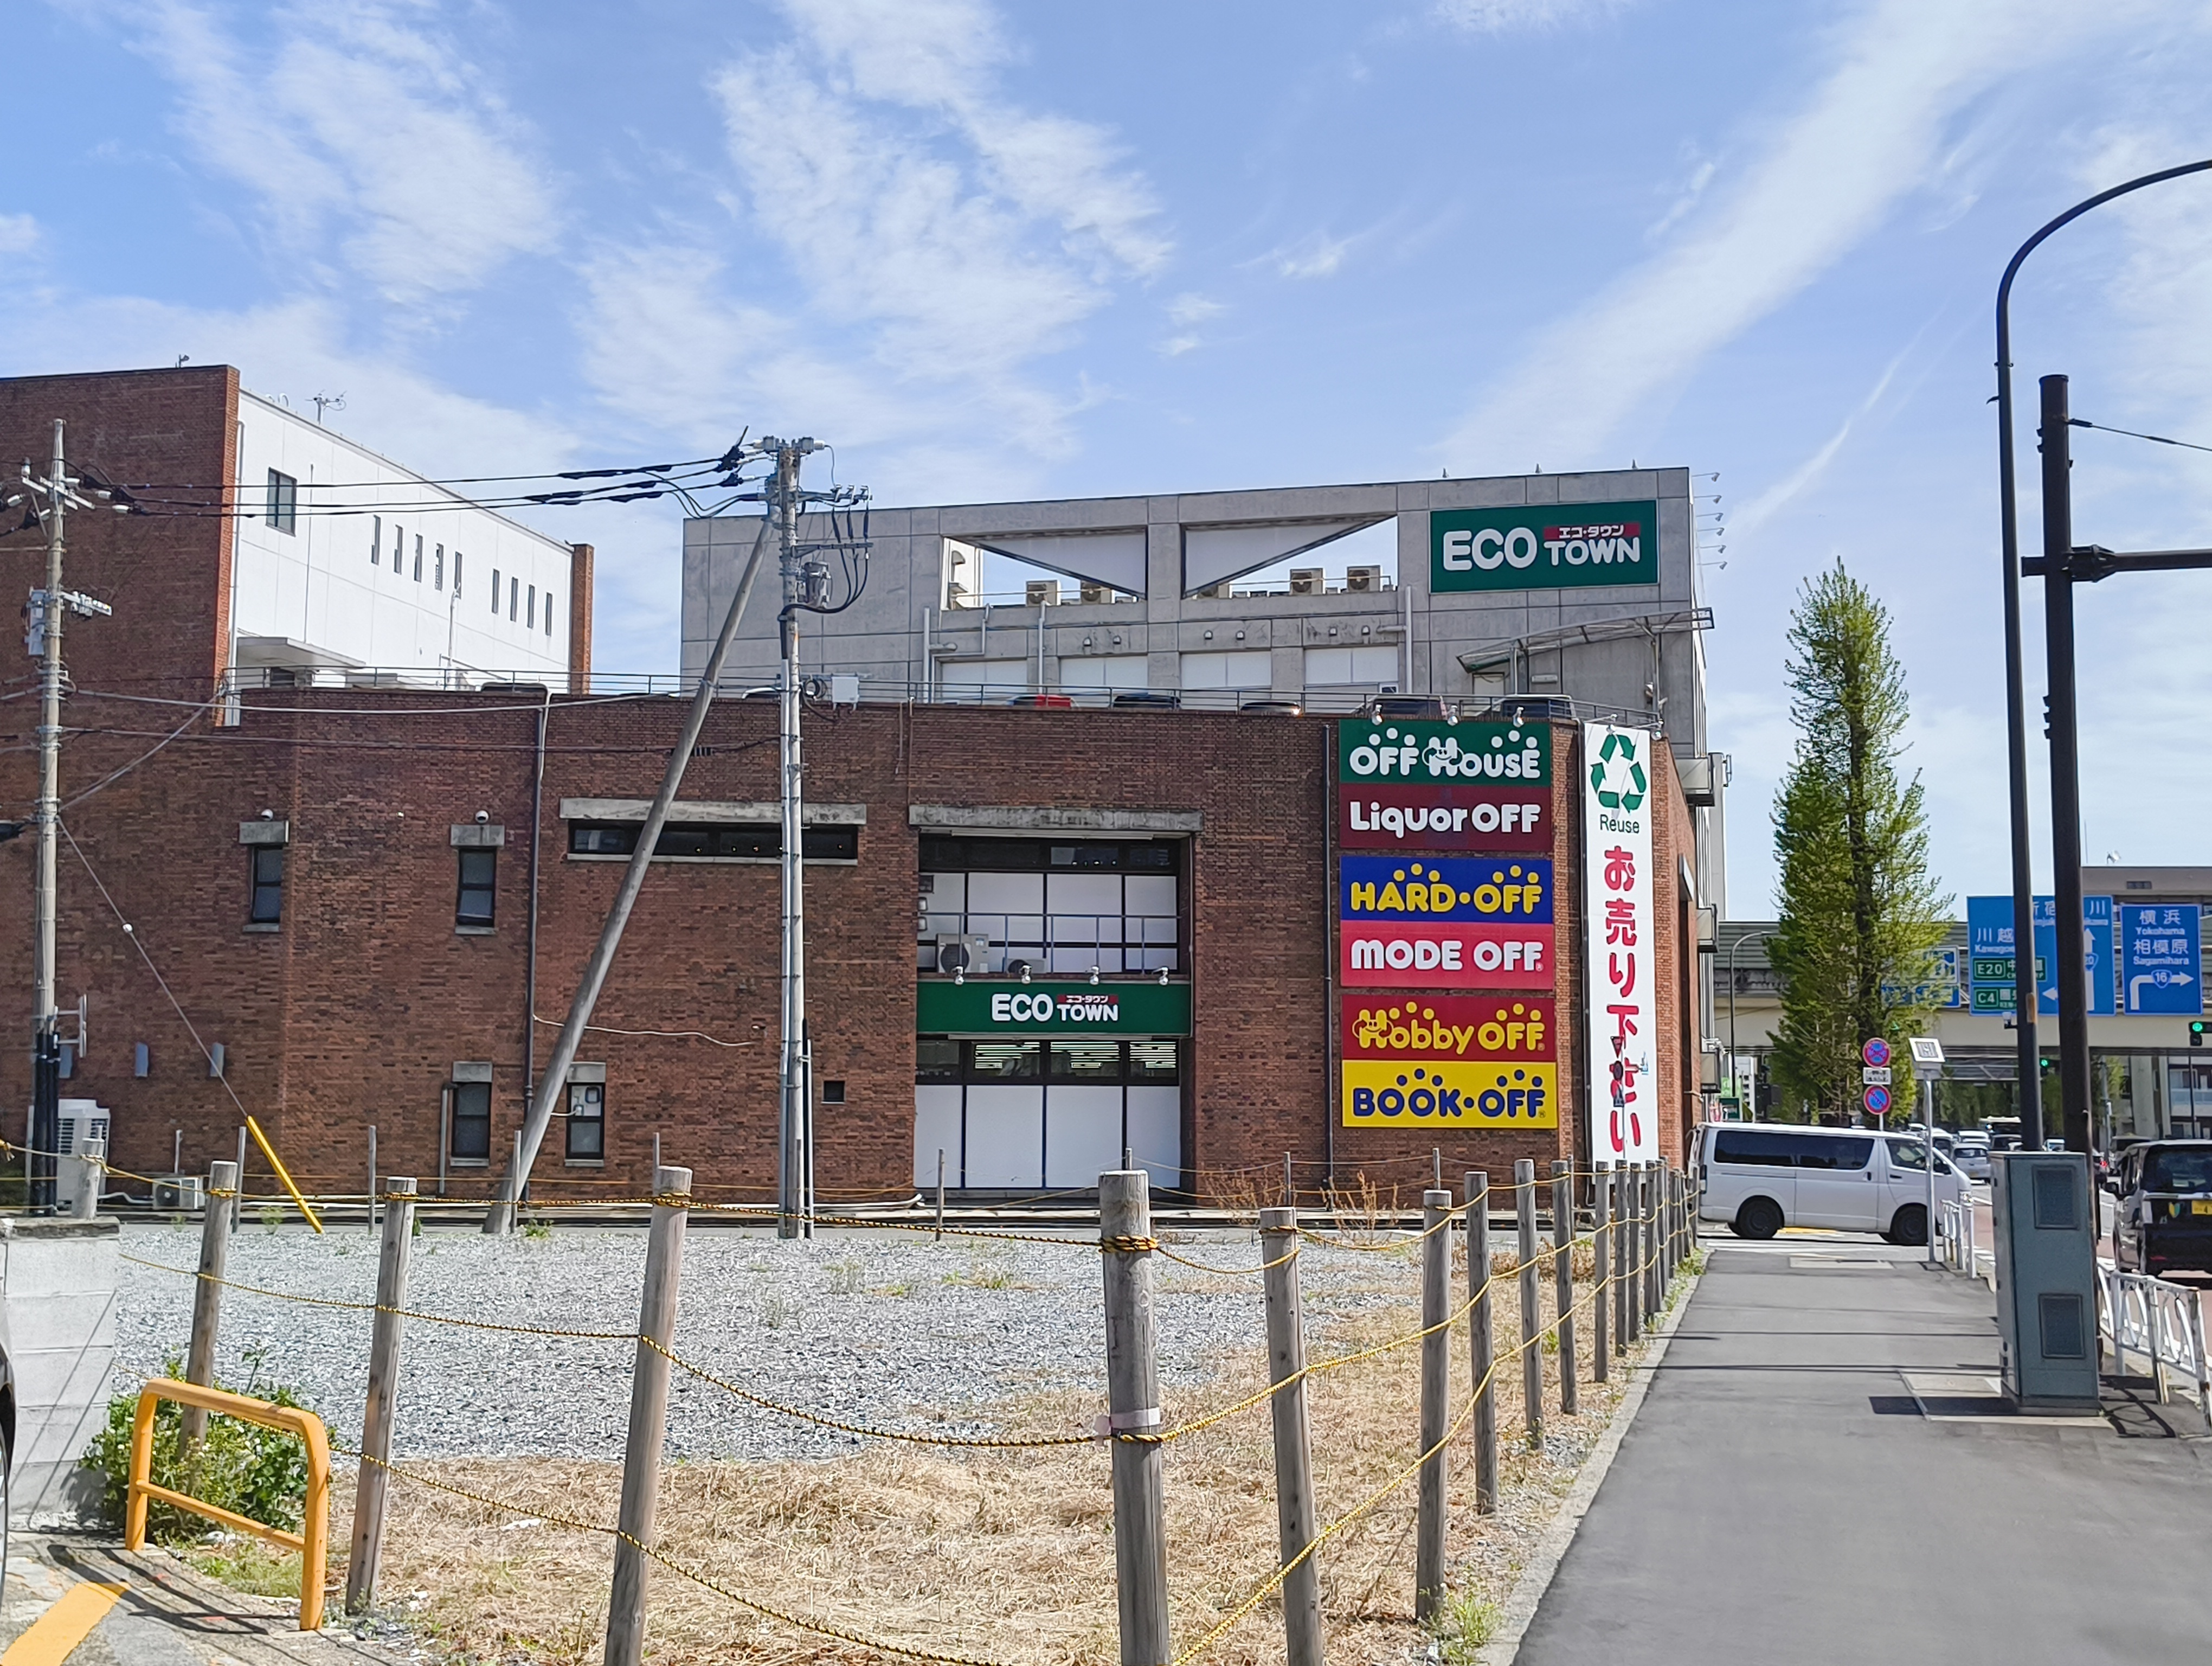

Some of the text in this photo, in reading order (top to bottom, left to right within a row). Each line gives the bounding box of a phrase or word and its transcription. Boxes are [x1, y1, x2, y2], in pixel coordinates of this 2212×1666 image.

[1559, 524, 1624, 538] エコ・タウン
[1443, 527, 1641, 571] ECO TOWN
[1349, 746, 1419, 776] OFF
[1349, 801, 1541, 838] Liquor OFF
[1600, 814, 1640, 834] Reuse
[2139, 909, 2181, 925] 横浜
[2134, 927, 2185, 935] Yokohama
[1351, 939, 1544, 971] MODE OFF
[2133, 939, 2189, 954] 相模原
[1977, 964, 2003, 975] E20
[2155, 972, 2168, 983] 16
[1978, 992, 1995, 1003] C4
[991, 994, 1118, 1022] ECO TOWN
[1356, 1009, 1545, 1055] Hobby OFF
